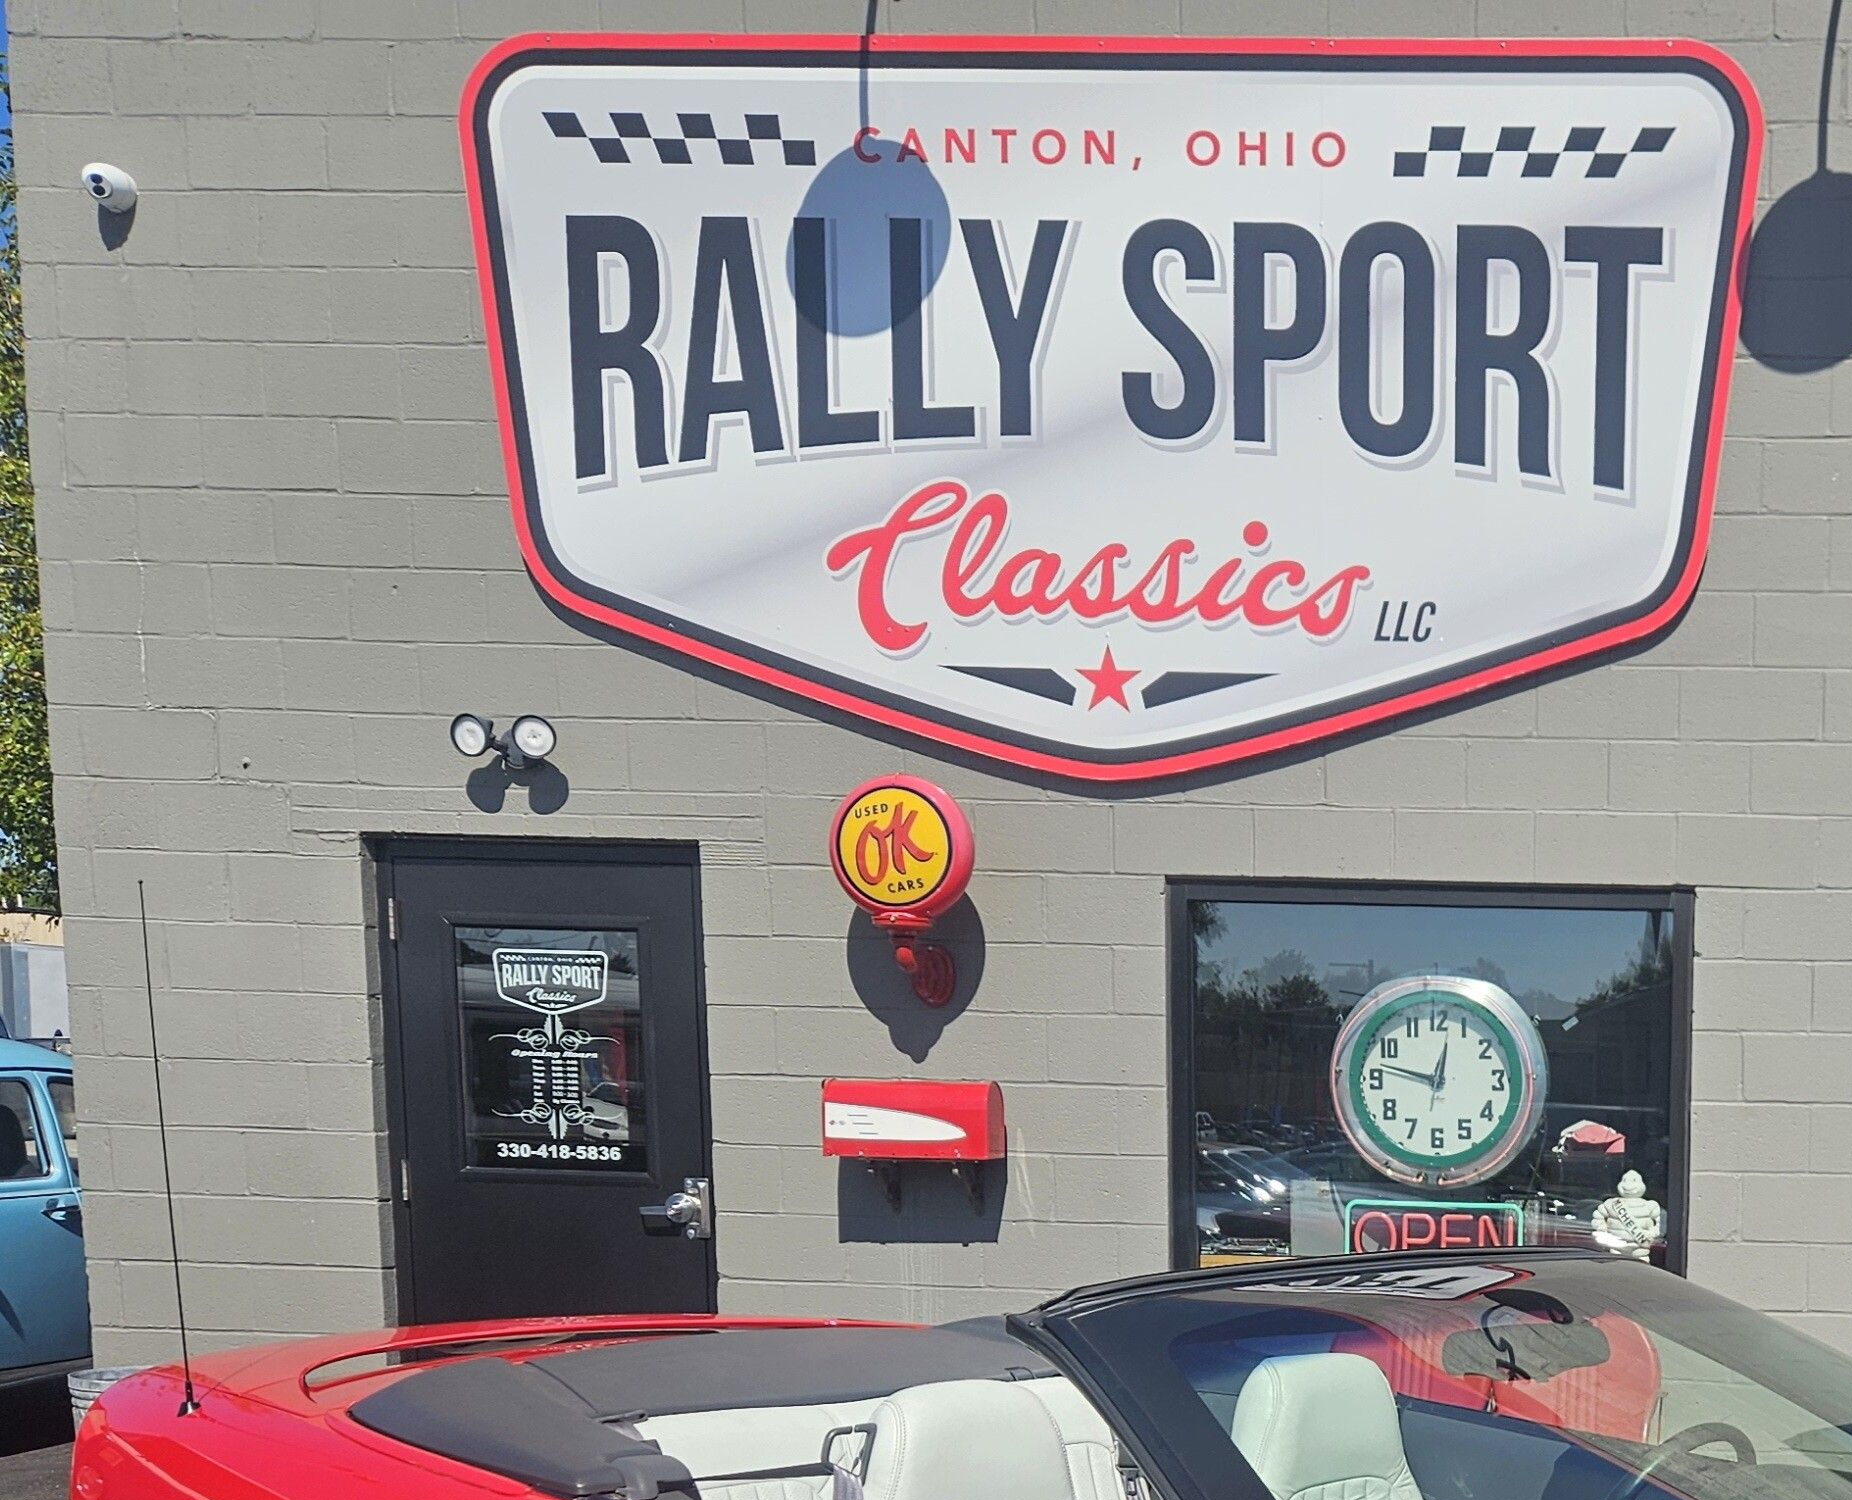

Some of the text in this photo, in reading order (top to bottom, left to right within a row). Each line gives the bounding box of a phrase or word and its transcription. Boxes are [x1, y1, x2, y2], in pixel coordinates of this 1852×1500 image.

[854, 125, 1347, 170] CANTON, OHIO
[565, 214, 1664, 490] RALLY SPORT
[826, 481, 1436, 652] Classics LLC
[854, 803, 889, 819] USED
[856, 802, 935, 887] OK
[887, 878, 925, 893] CARS
[501, 963, 602, 990] RALLY SPORT
[526, 987, 578, 1004] Classics
[1406, 1016, 1419, 1038] 11
[1429, 1009, 1448, 1032] 12
[1461, 1017, 1467, 1038] 1
[1380, 1037, 1398, 1059] 10
[1478, 1038, 1492, 1060] 2
[1369, 1068, 1383, 1090] 9
[1491, 1069, 1505, 1091] 3
[1383, 1098, 1397, 1121] 8
[1479, 1099, 1494, 1122] 4
[1404, 1117, 1418, 1139] 7
[1430, 1127, 1444, 1149] 6
[1457, 1118, 1472, 1140] 5
[497, 1142, 622, 1161] 330-418-5836
[1353, 1210, 1516, 1253] OPEN
[1613, 1199, 1649, 1244] MICHELIN
